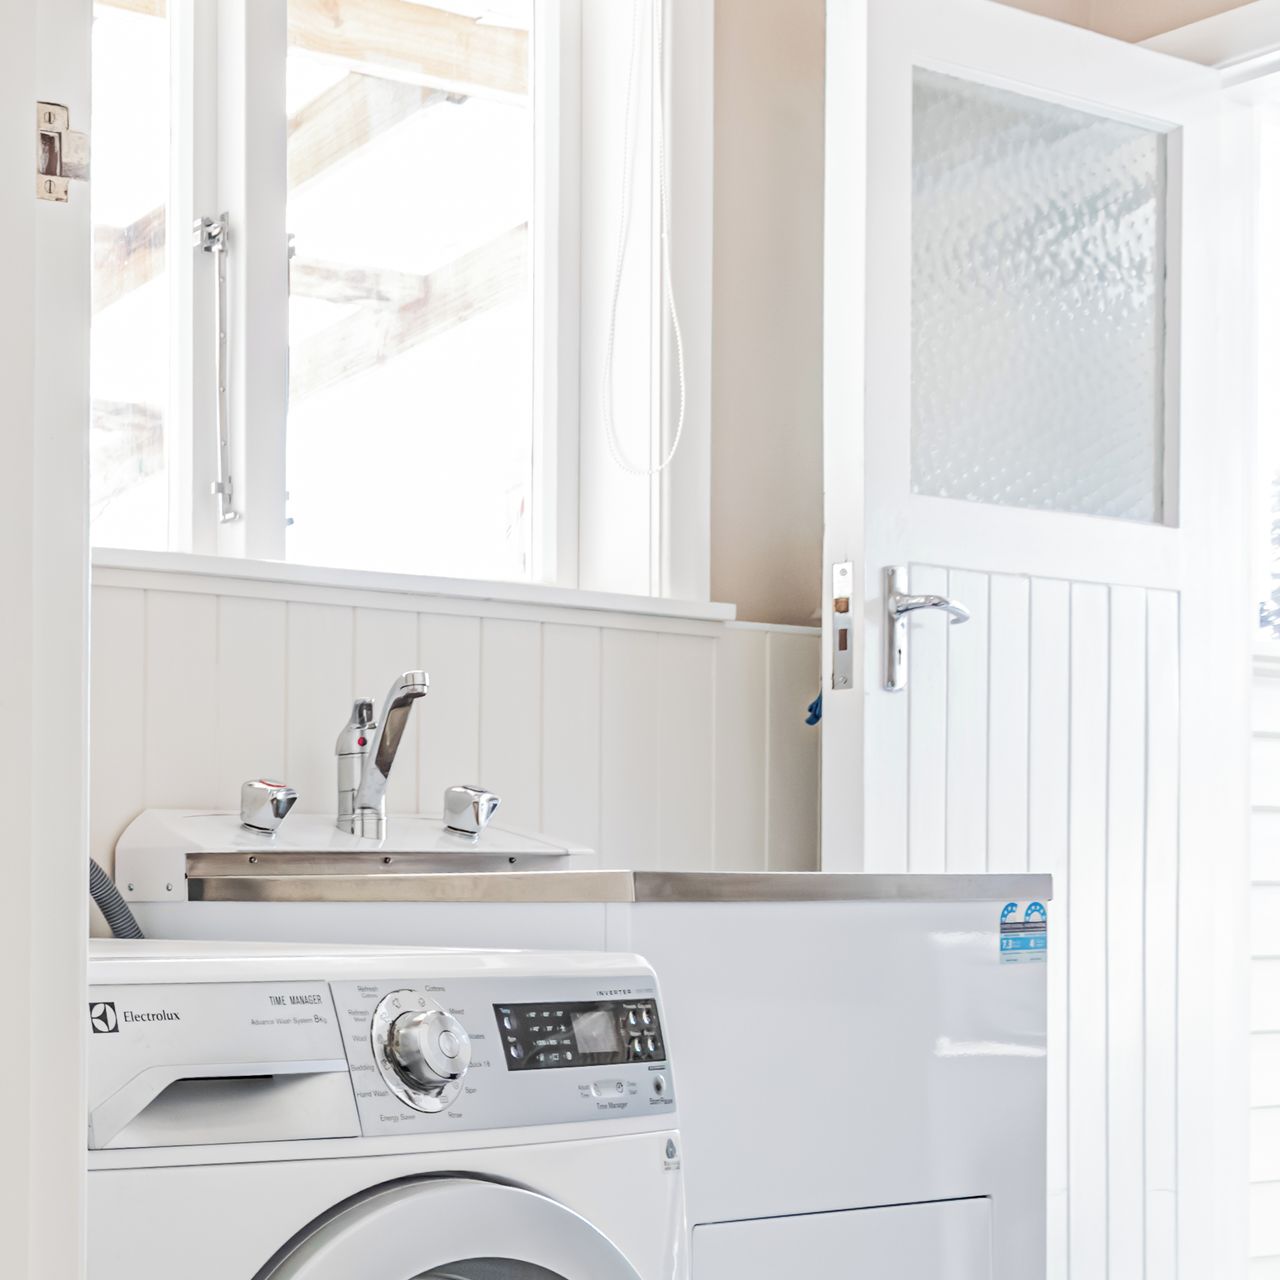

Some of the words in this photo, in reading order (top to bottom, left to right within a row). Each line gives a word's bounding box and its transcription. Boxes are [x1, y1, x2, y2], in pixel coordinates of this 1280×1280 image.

[269, 995, 286, 1006] TIME
[290, 994, 322, 1005] MANAGER
[123, 1009, 180, 1023] Electrolux
